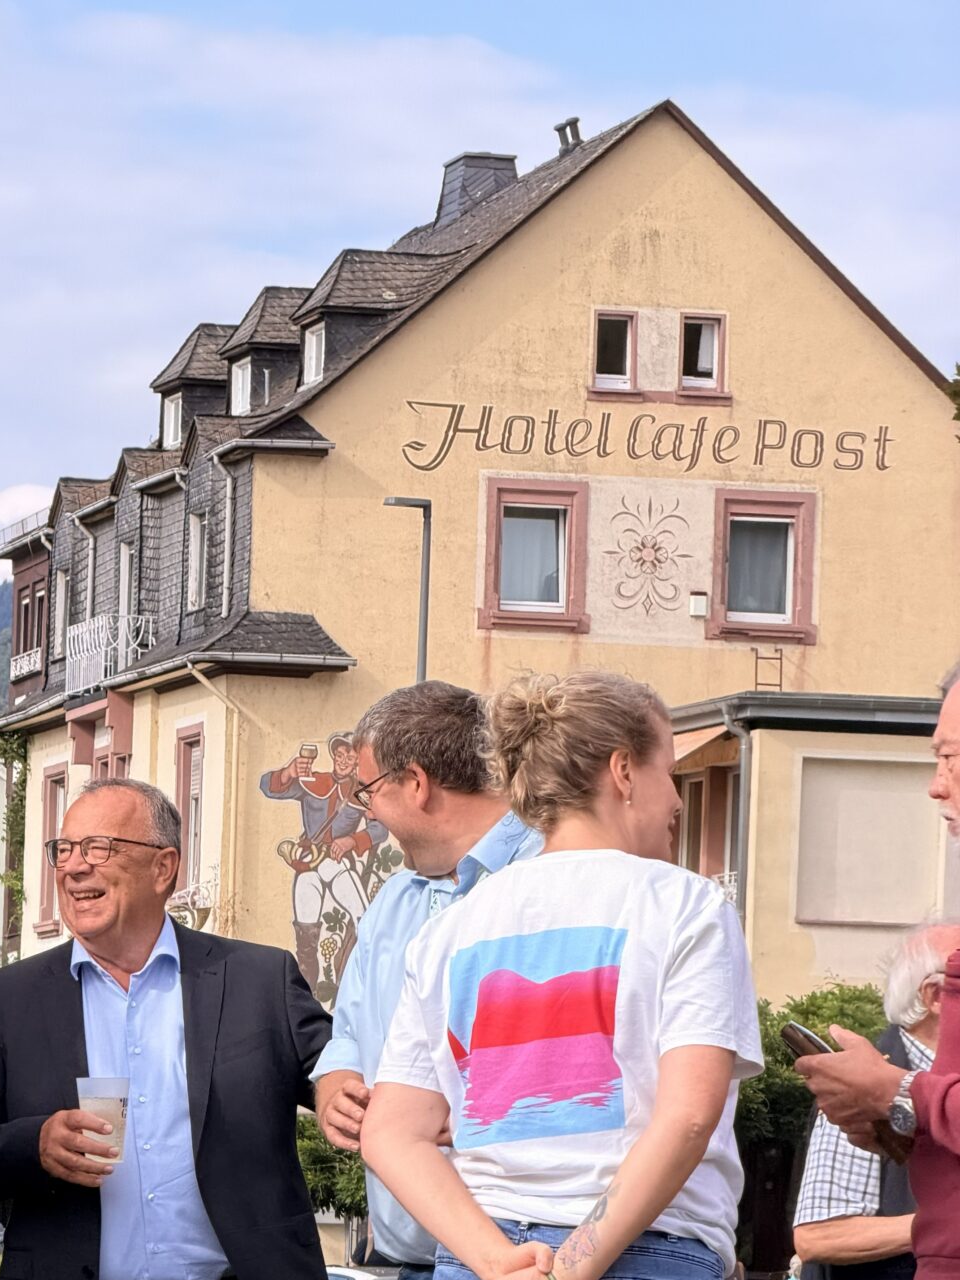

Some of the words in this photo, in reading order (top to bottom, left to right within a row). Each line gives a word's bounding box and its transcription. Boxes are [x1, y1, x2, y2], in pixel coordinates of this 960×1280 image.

[402, 400, 615, 472] Hotel
[626, 413, 740, 474] Cafe
[753, 418, 899, 472] Post
